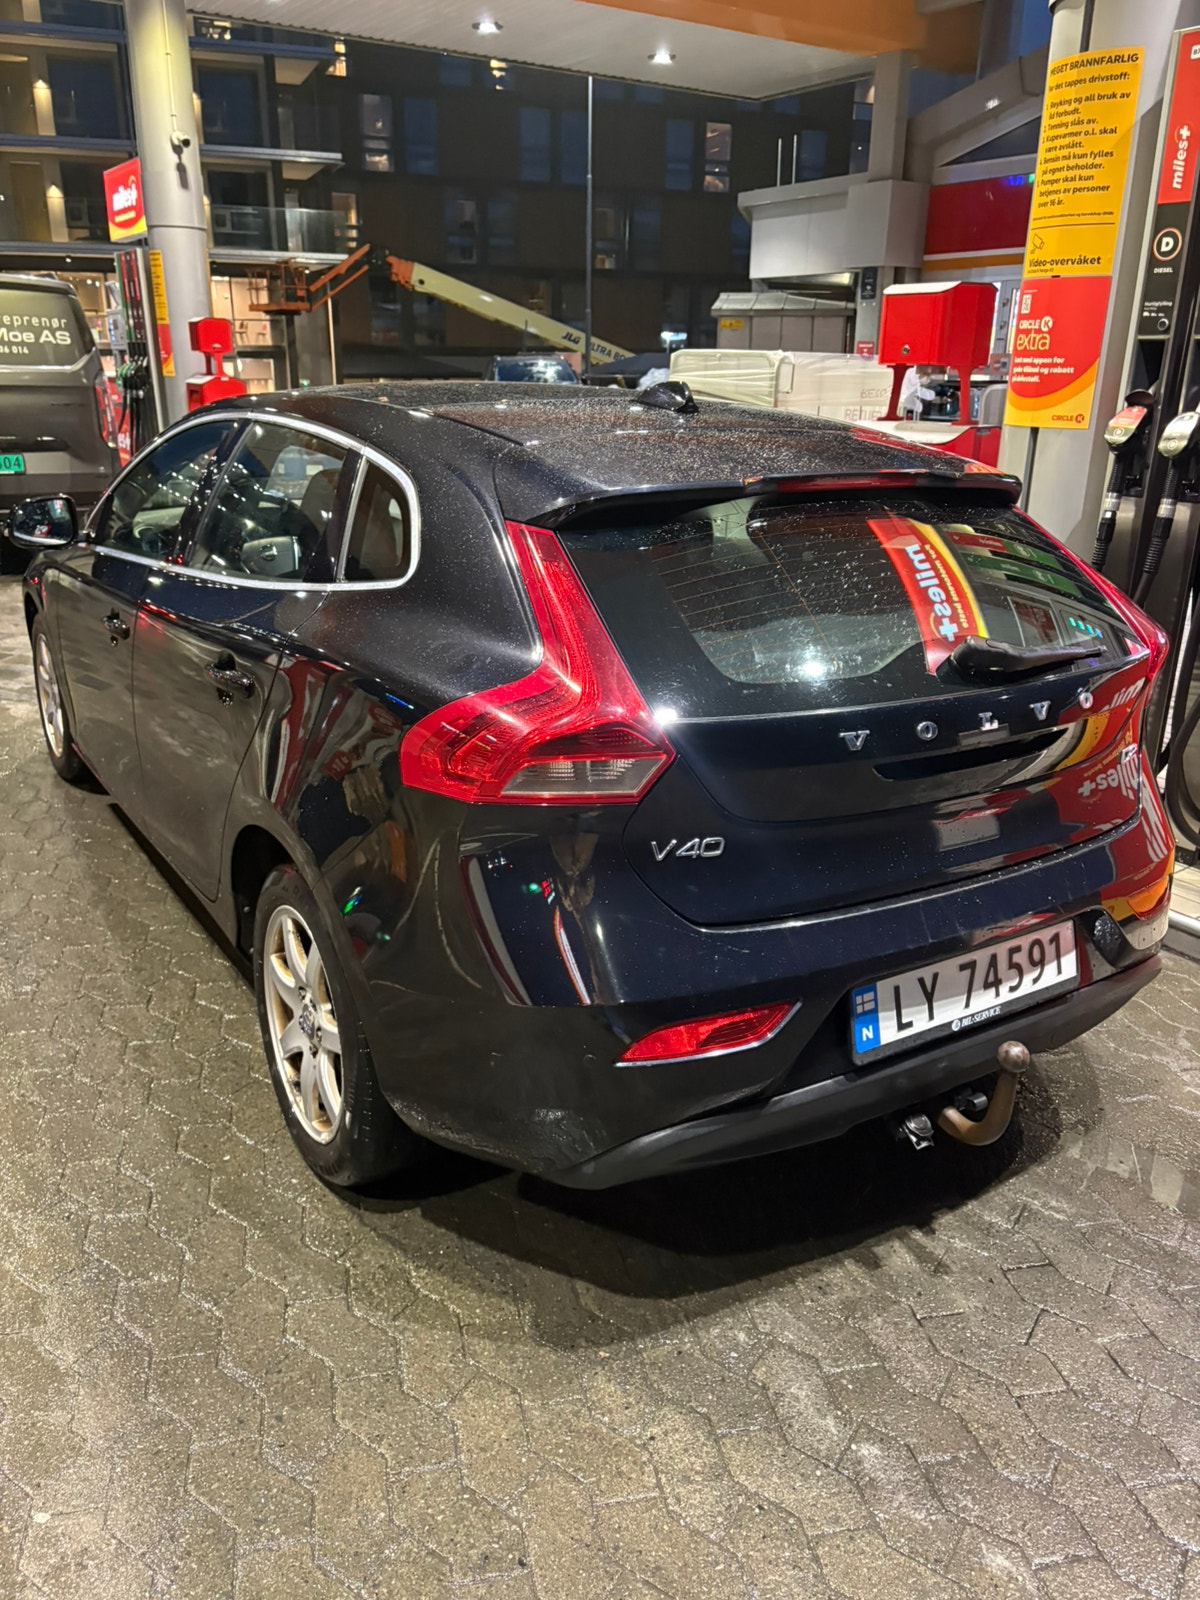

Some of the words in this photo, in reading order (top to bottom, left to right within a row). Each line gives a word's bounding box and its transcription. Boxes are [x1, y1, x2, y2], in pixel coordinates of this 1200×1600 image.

[1069, 53, 1139, 71] BRANNFARLIG
[1064, 77, 1087, 88] tappes
[1088, 72, 1131, 84] drivstoff:
[1073, 96, 1083, 105] og
[1084, 93, 1096, 102] all
[1097, 92, 1118, 101] bruk
[1070, 116, 1084, 127] slås
[1084, 128, 1097, 136] o.l.
[1098, 126, 1118, 136] skal
[1061, 152, 1072, 161] må
[1072, 152, 1088, 160] kun
[1089, 150, 1114, 161] fylles
[1172, 125, 1191, 189] miles+
[1066, 162, 1105, 171] beholder.
[1062, 174, 1077, 183] skal
[1078, 174, 1094, 182] kun
[1072, 184, 1110, 195] personer
[1160, 236, 1174, 252] D
[1029, 255, 1101, 268] Video-overvåket
[0, 315, 68, 329] eprenør
[1019, 319, 1040, 330] CIRCLE
[39, 329, 72, 345] AS
[562, 331, 581, 345] JLG
[1016, 329, 1051, 351] extra
[590, 341, 612, 358] LTRA
[1053, 356, 1065, 364] for
[1040, 367, 1049, 375] og
[1049, 366, 1075, 374] rabatt
[0, 456, 22, 470] 04
[838, 692, 1094, 751] VOLVO
[651, 836, 725, 861] V40
[893, 971, 940, 1033] LY
[958, 931, 1063, 1010] 74591
[861, 1025, 874, 1042] N
